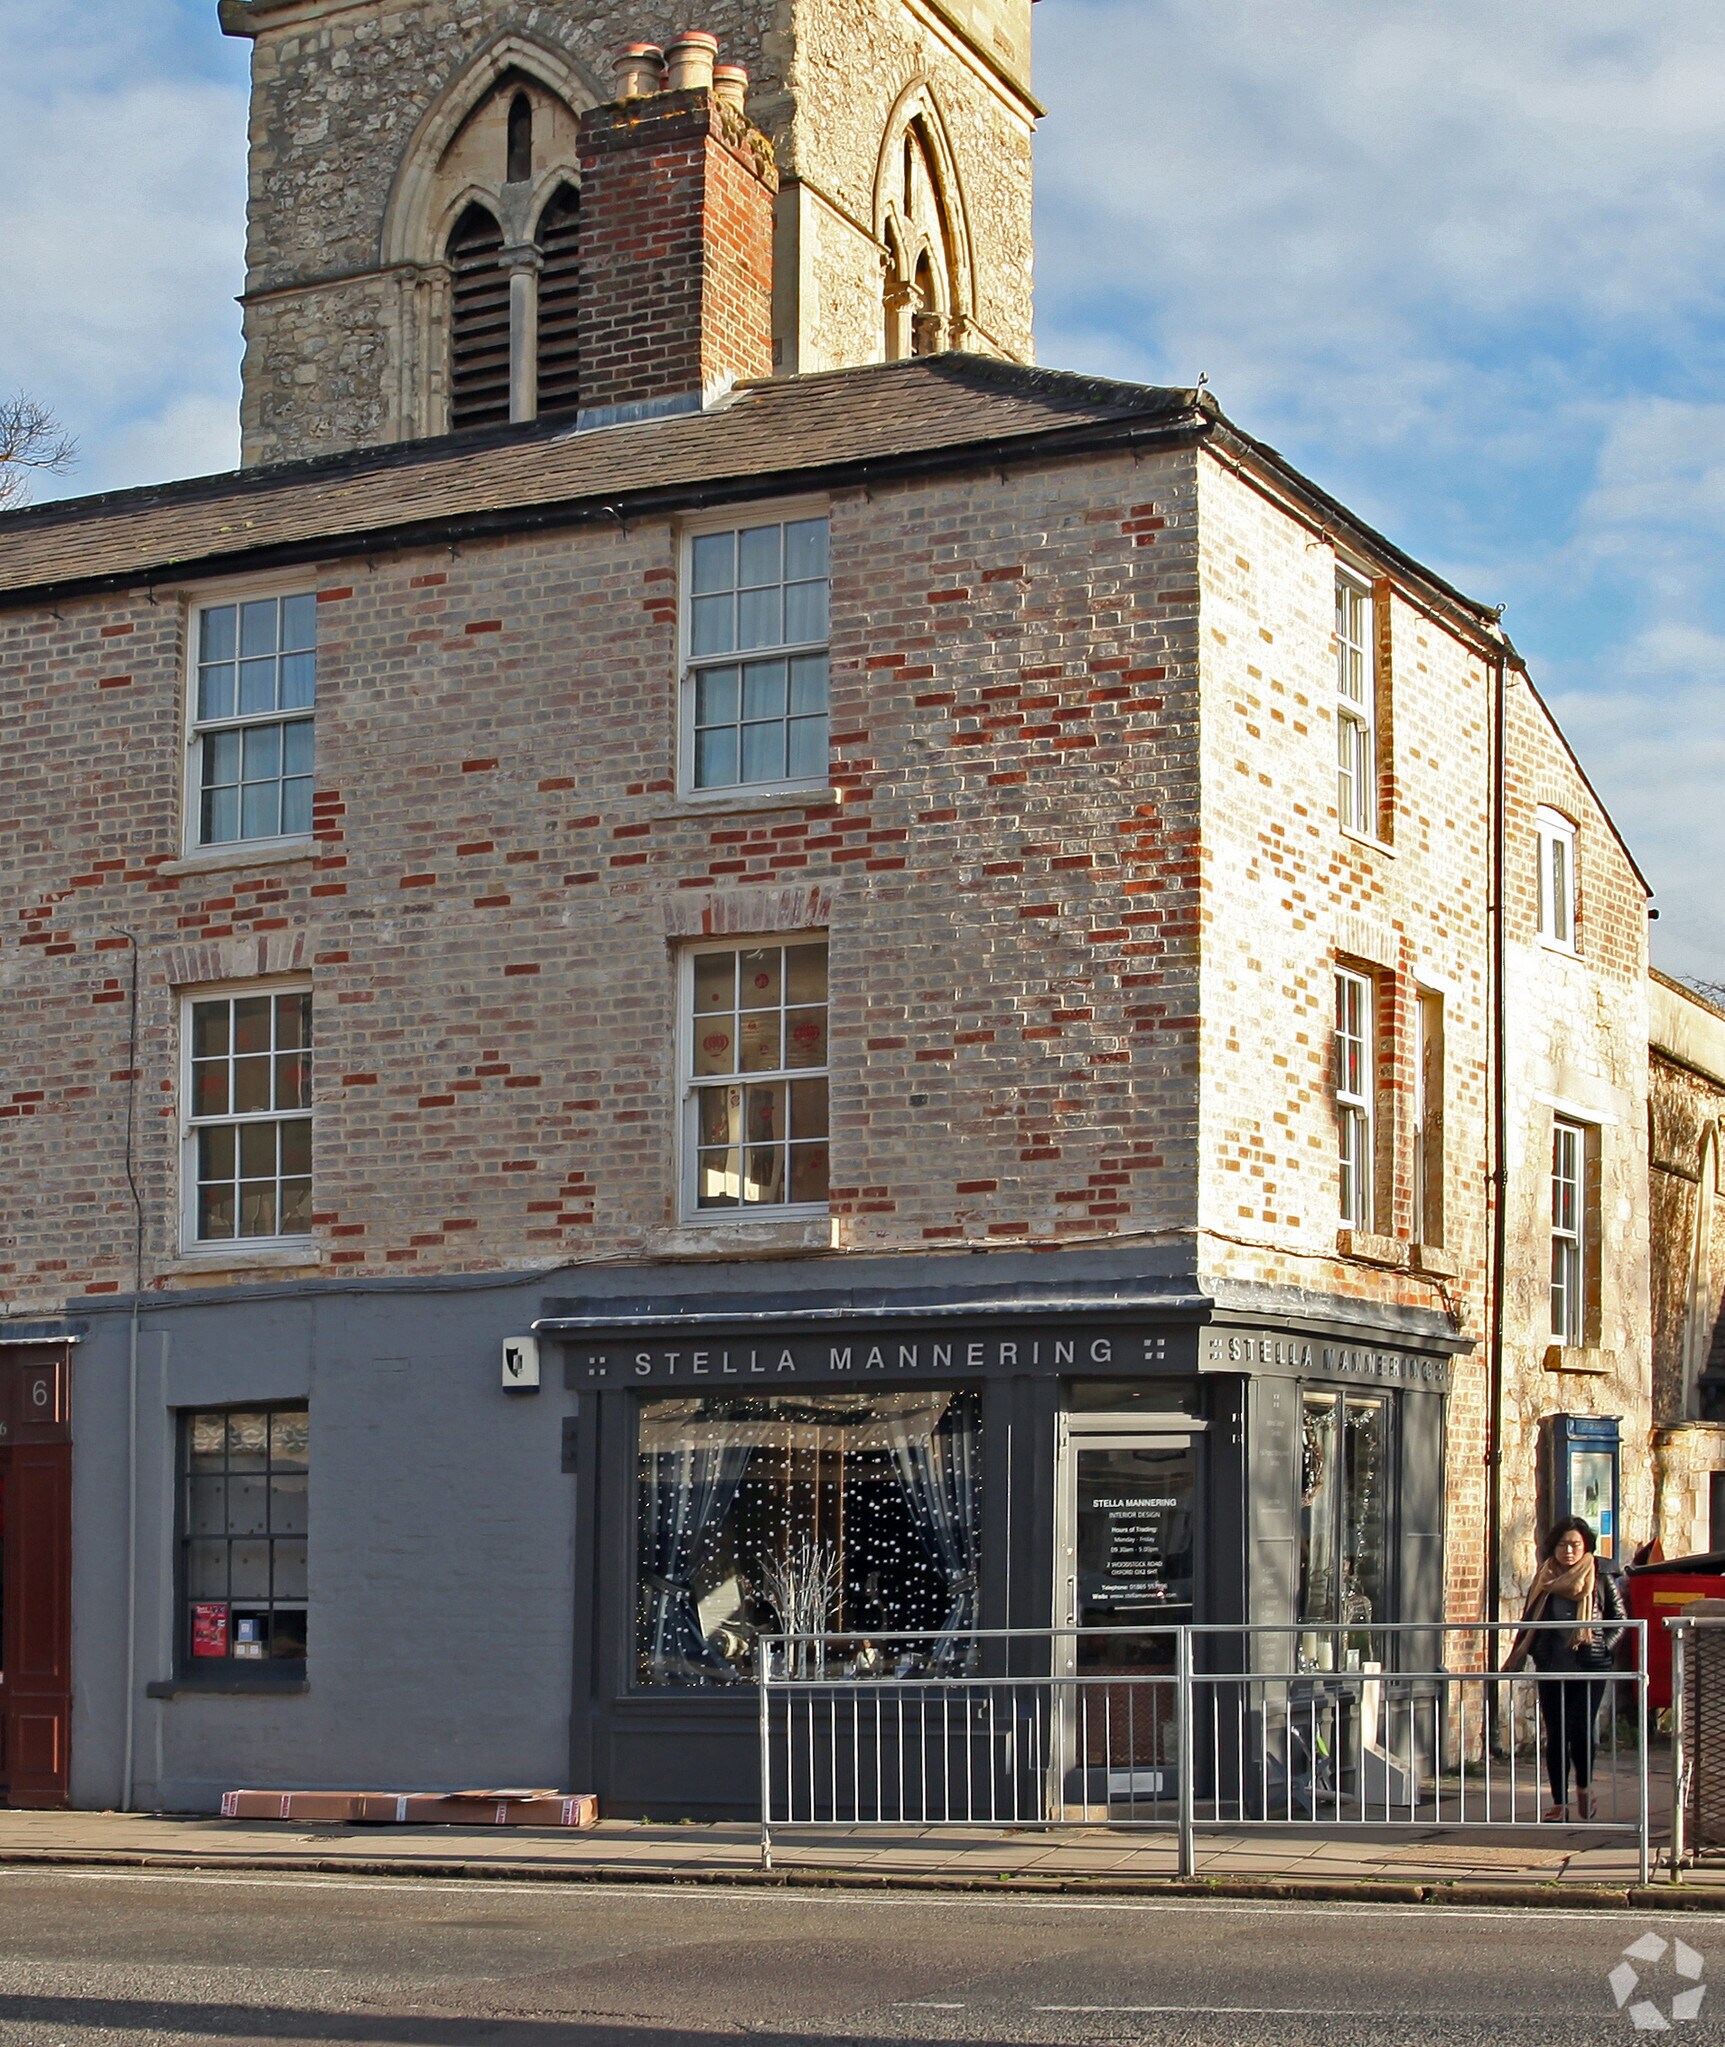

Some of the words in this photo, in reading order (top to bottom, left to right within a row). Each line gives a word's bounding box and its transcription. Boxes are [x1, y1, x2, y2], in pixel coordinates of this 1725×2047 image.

[635, 1350, 797, 1376] STELLA
[829, 1338, 1114, 1371] MANNERING
[1229, 1336, 1313, 1367] STELLA
[1322, 1347, 1433, 1381] MANNERING
[33, 1380, 47, 1406] 6
[1092, 1499, 1124, 1507] STELLA
[1125, 1498, 1177, 1507] MANNERING
